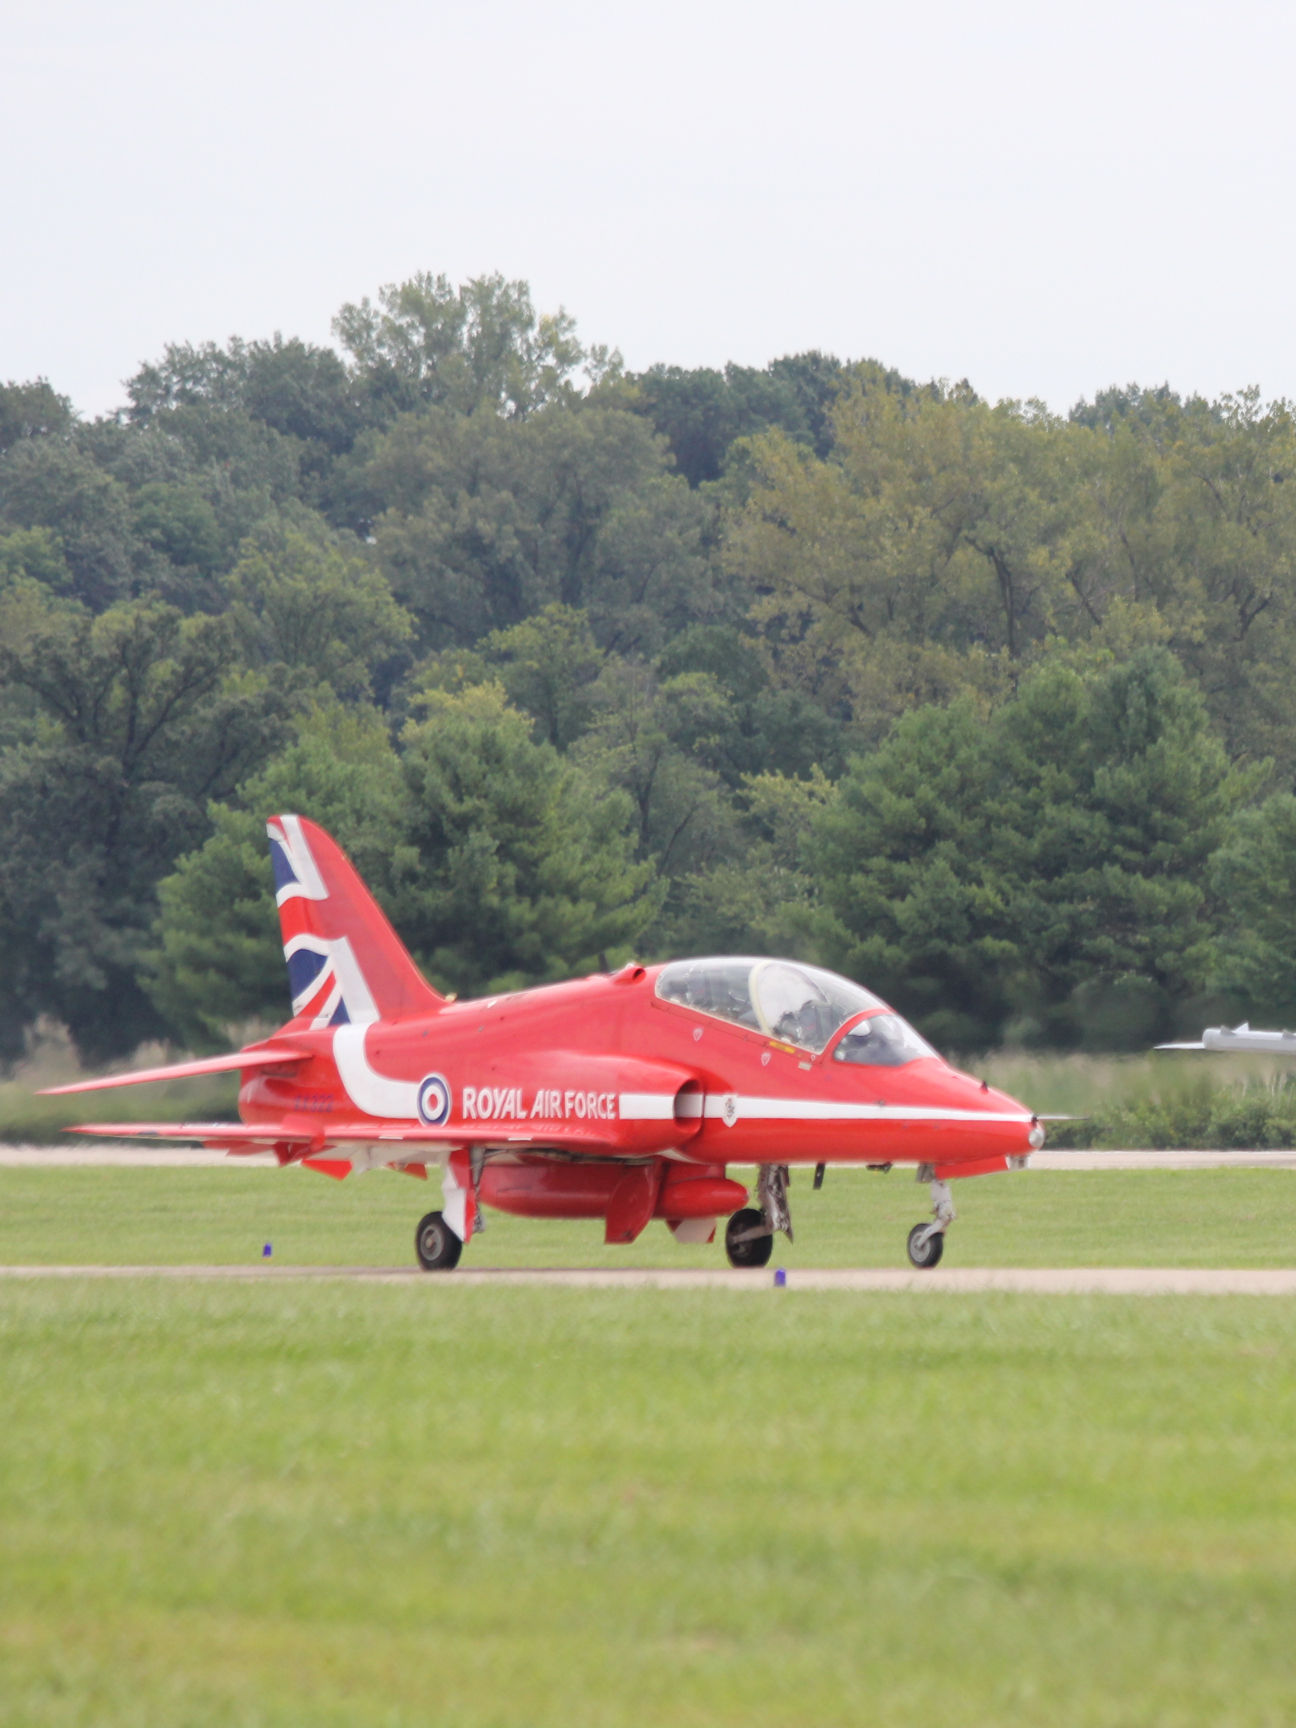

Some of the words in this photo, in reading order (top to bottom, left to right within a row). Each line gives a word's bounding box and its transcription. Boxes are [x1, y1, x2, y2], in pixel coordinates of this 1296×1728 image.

[462, 1087, 528, 1120] ROYAL
[530, 1089, 562, 1119] AIR
[564, 1091, 616, 1120] FORCE
